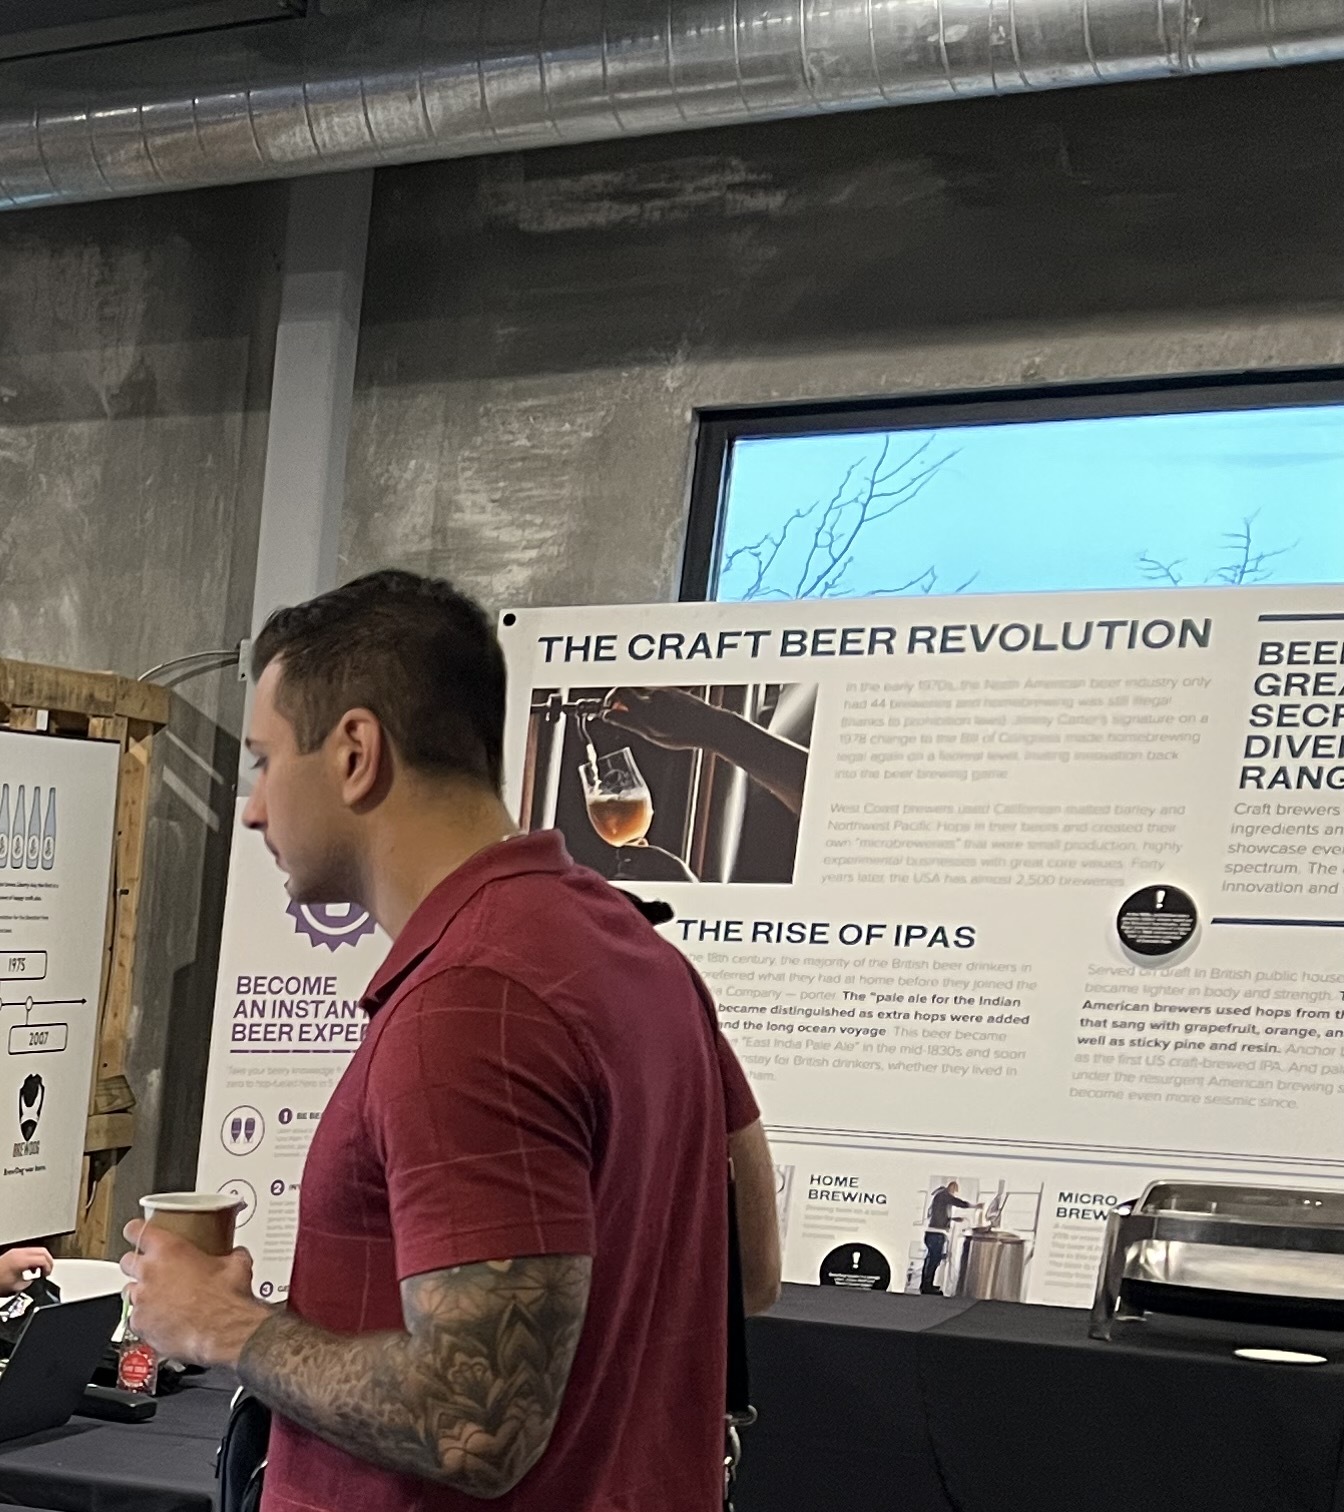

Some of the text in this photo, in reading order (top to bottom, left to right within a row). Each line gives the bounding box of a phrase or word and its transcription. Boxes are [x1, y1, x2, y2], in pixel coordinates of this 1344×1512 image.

[537, 617, 1211, 663] THE CRAFT BEER REVOLUTION
[1257, 640, 1344, 666] BEE
[1253, 671, 1344, 697] GRE
[1243, 734, 1344, 759] DIVE
[676, 919, 976, 948] THE RISE OF IPAS
[235, 975, 338, 996] BECOME
[232, 999, 367, 1019] AN INSTAN
[1081, 999, 1150, 1012] American
[1153, 1002, 1212, 1015] brewers
[1215, 1005, 1252, 1016] used
[1255, 1005, 1292, 1019] hops
[1295, 1007, 1331, 1019] from
[28, 1030, 49, 1046] 2007
[231, 1022, 294, 1042] BEER
[1079, 1017, 1108, 1028] that
[1111, 1020, 1146, 1032] sang
[1149, 1020, 1180, 1031] with
[1183, 1022, 1260, 1036] grapefruit,
[1264, 1026, 1321, 1039] orange,
[1077, 1035, 1281, 1054] well as sticky pine and resin.
[809, 1174, 858, 1188] HOME
[807, 1188, 887, 1205] BREWING
[1057, 1191, 1119, 1209] MICRO
